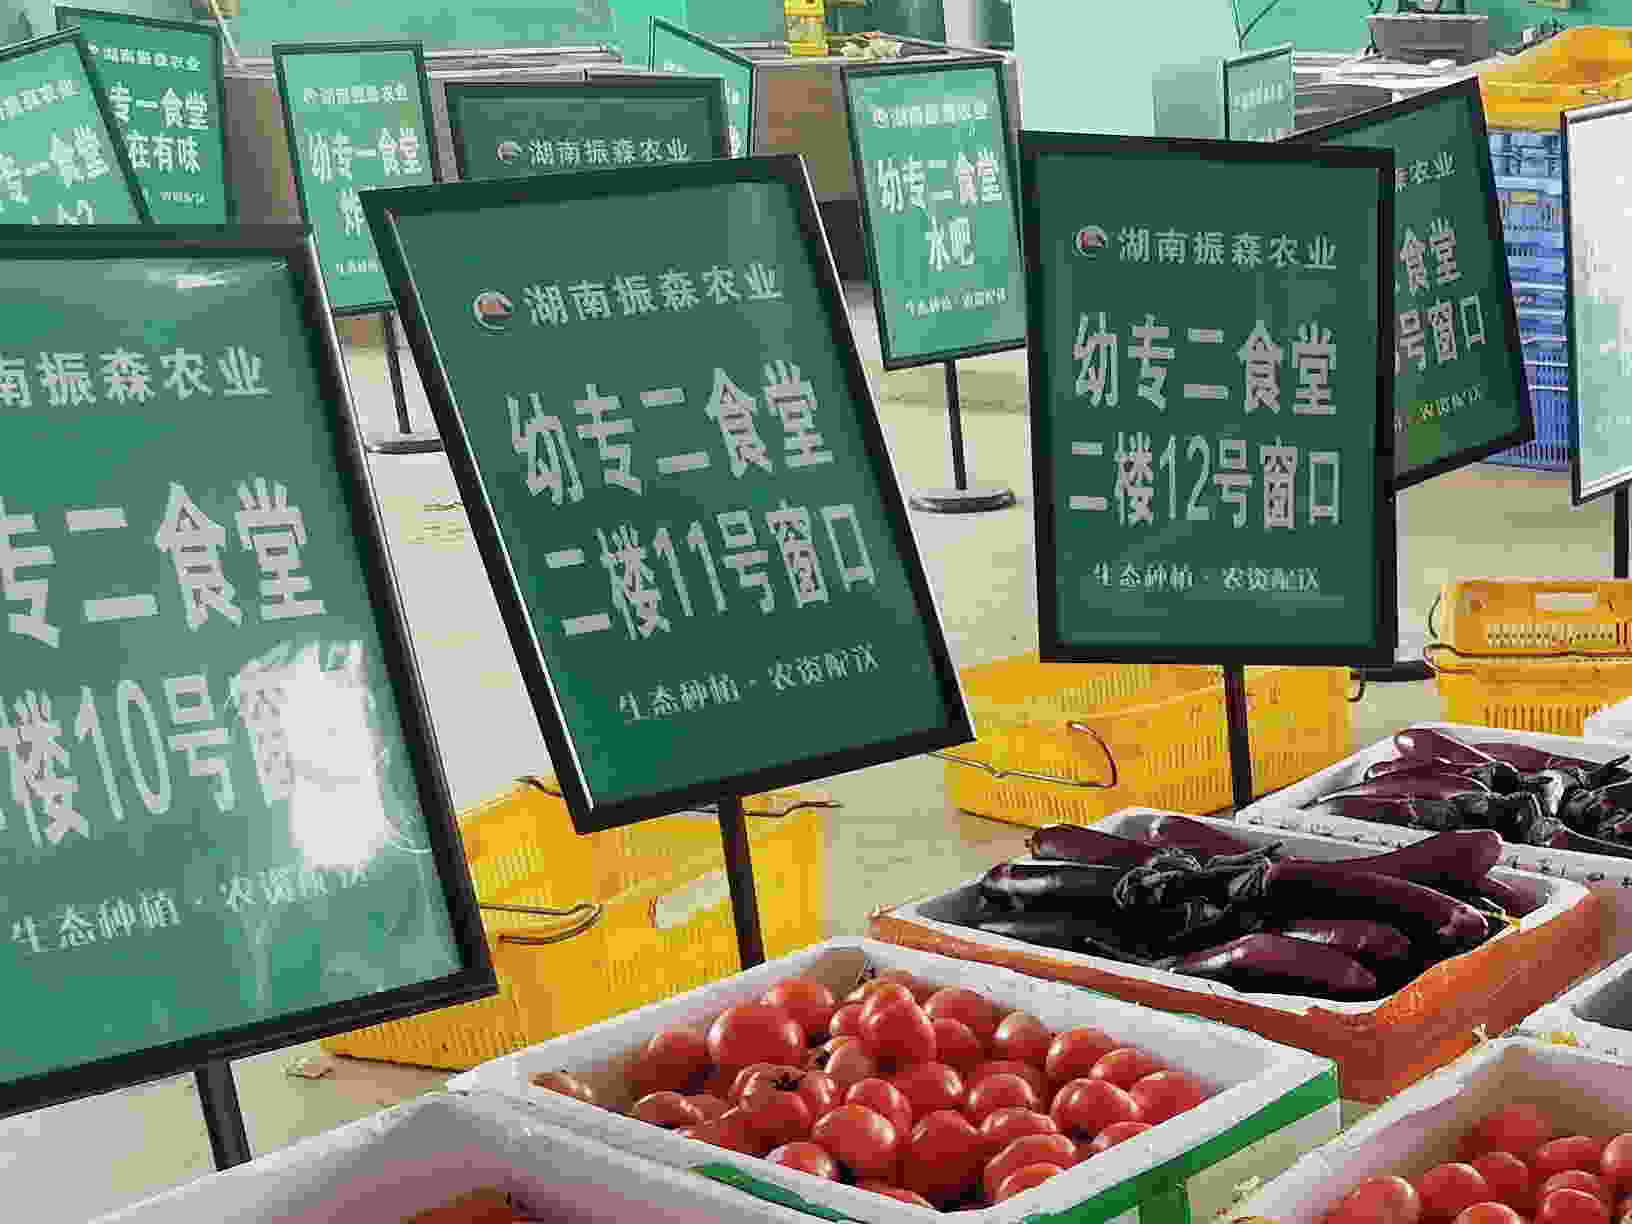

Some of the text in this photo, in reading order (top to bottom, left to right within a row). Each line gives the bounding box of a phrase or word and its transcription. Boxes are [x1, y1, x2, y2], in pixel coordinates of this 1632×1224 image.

[528, 137, 689, 168] 湖南振森农业
[878, 147, 1003, 214] 幼专二食堂
[924, 214, 976, 272] 水吧
[1117, 227, 1337, 271] 湖南振森农业
[522, 262, 786, 327] 湖南振森农业
[1071, 310, 1337, 416] 幼专二食堂
[506, 359, 836, 505] 幼专二食堂
[1068, 431, 1342, 532] 二楼12号窗口
[543, 500, 877, 641] 二楼11号窗口
